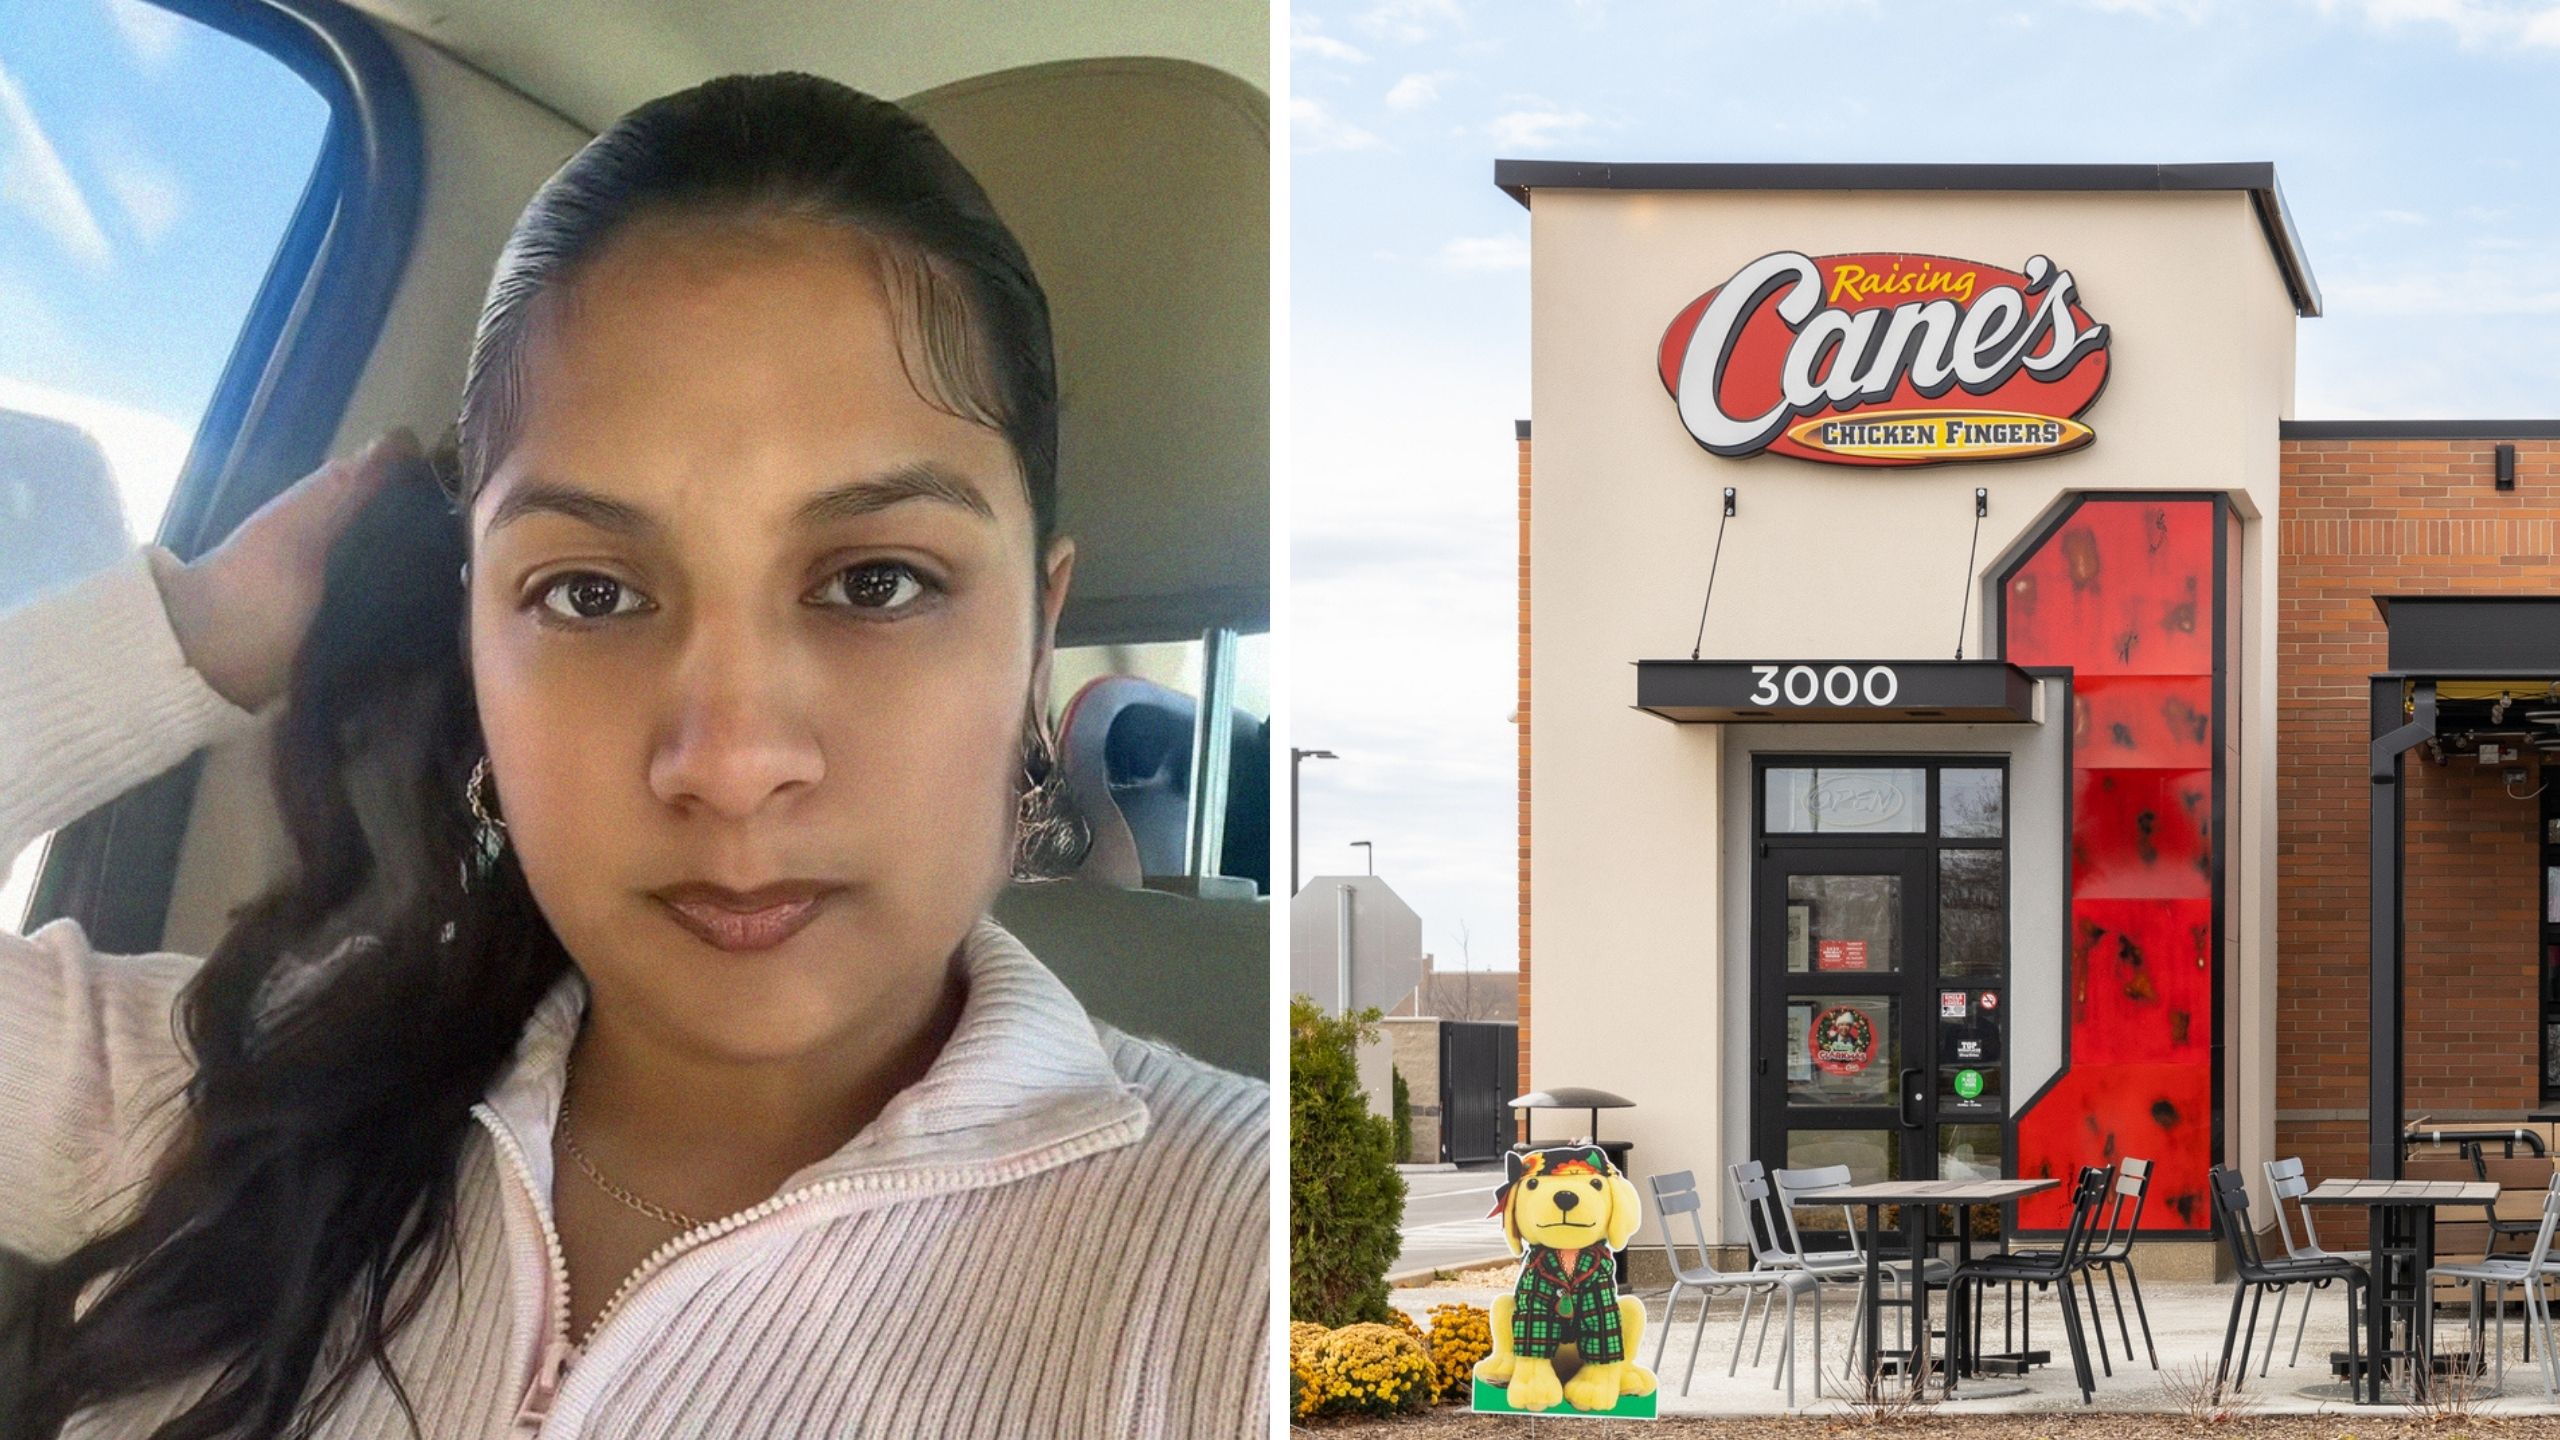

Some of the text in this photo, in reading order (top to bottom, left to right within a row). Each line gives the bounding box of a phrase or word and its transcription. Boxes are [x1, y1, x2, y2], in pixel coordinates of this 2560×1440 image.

[1829, 262, 1977, 302] Raising
[1676, 251, 2105, 450] Cane's
[1821, 420, 2059, 446] CHICKEN FINGERS
[1749, 665, 1898, 707] 3000
[1808, 788, 1896, 813] OPEN
